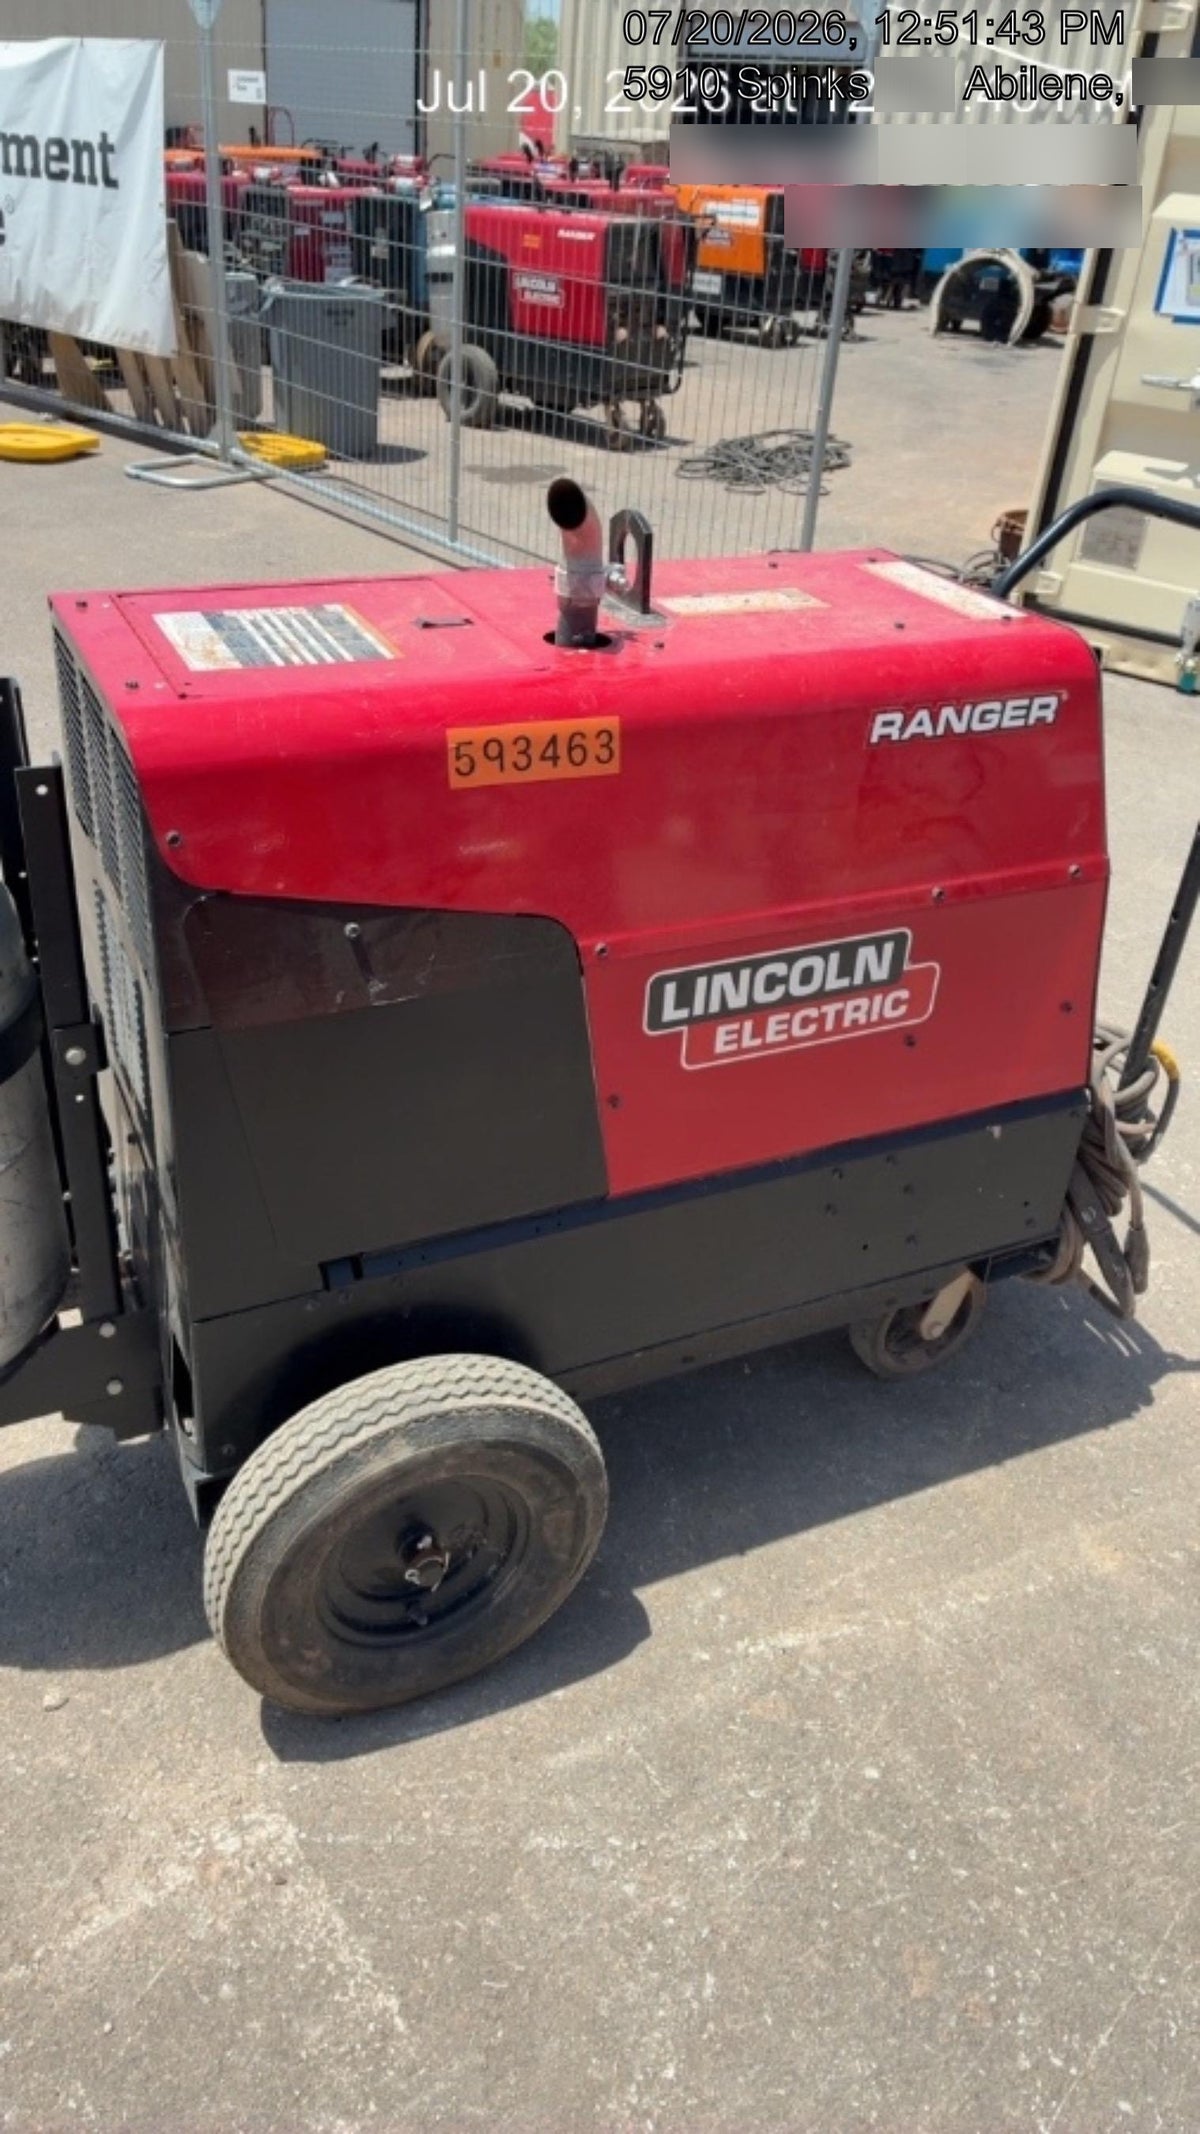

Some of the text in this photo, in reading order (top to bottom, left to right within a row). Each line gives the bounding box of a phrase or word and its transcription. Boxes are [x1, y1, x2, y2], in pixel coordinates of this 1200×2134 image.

[869, 696, 1060, 744] RANGER
[454, 729, 615, 777] 593463
[661, 941, 895, 1022] LINCOLN
[714, 989, 910, 1054] ELECTRIC
